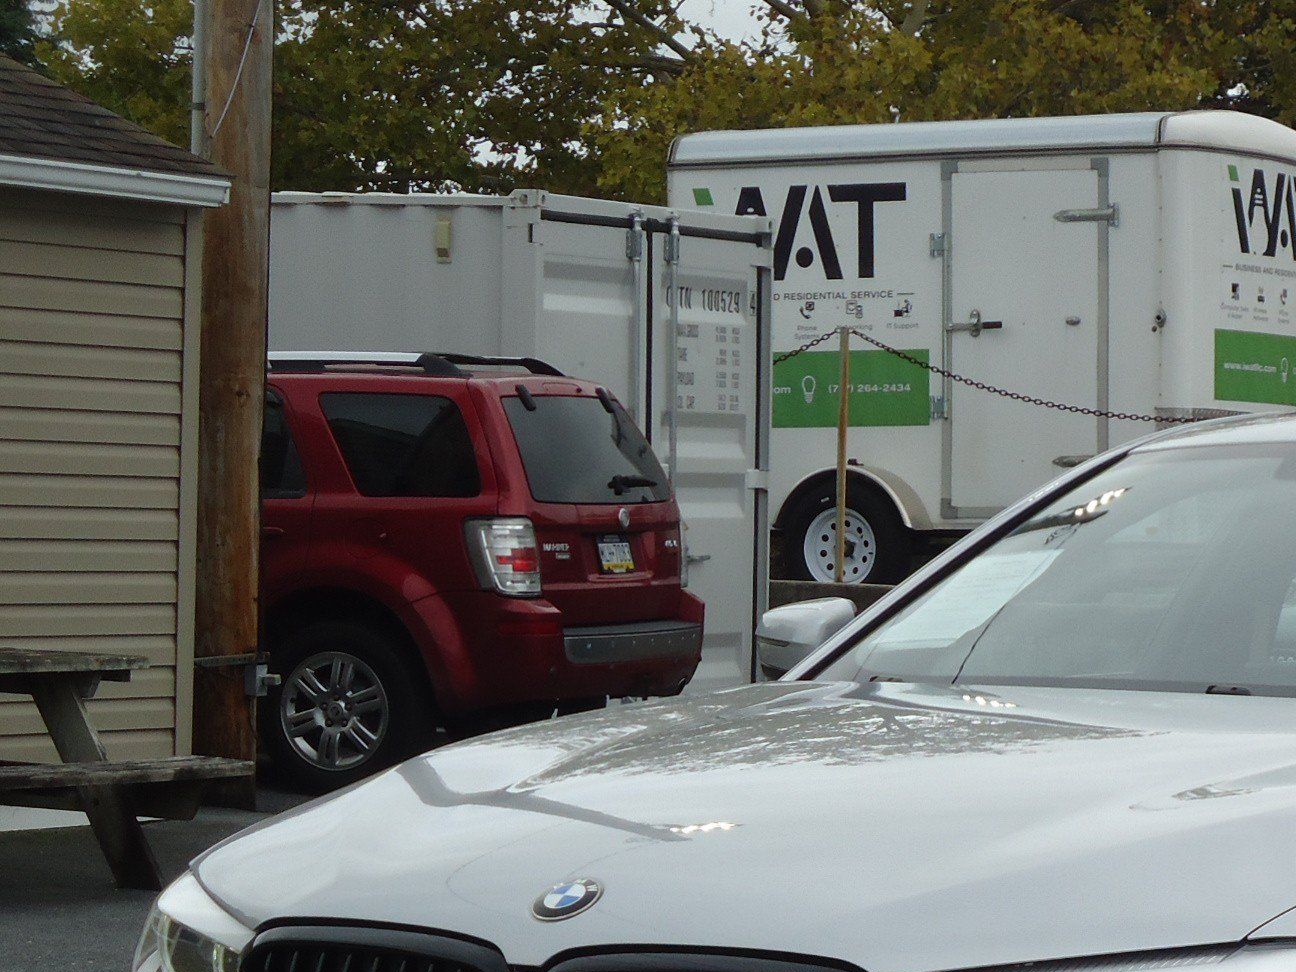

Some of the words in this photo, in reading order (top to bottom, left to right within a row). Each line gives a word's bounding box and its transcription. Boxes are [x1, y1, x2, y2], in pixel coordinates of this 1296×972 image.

[784, 292, 847, 300] RESIDENTIAL
[850, 290, 894, 299] SERVICE
[857, 383, 912, 393] 264-2434
